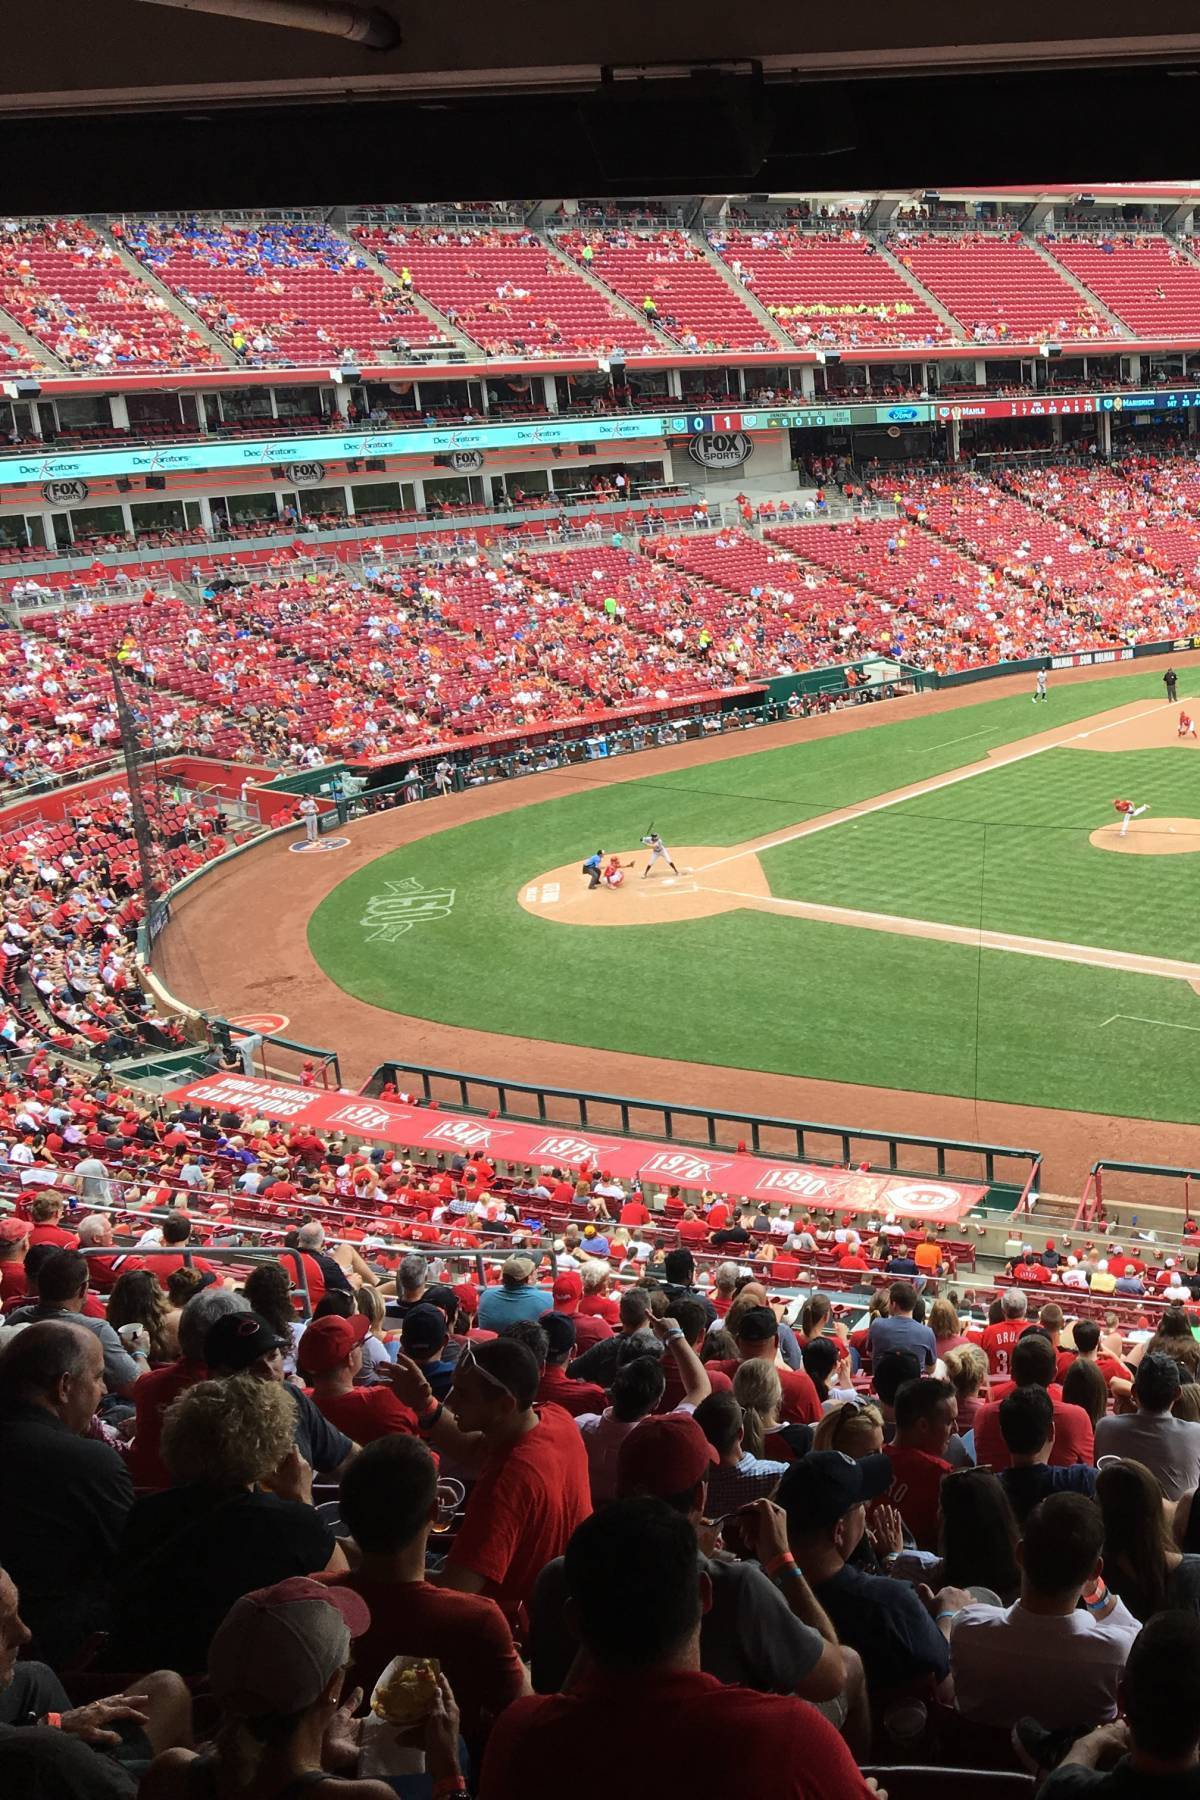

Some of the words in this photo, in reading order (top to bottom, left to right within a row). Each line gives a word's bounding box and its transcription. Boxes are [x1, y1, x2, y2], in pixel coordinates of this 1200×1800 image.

[694, 418, 704, 430] 0
[723, 416, 731, 429] 1
[702, 434, 739, 452] FOX
[456, 452, 478, 463] FOX
[703, 452, 741, 461] SPORTS
[293, 464, 318, 475] FOX
[52, 483, 79, 495] FOX
[186, 1086, 307, 1116] CHAMPIONS
[216, 1078, 272, 1094] WORLD
[264, 1087, 321, 1104] SERIES
[336, 1105, 386, 1129] 1919
[438, 1120, 488, 1145] 1940
[543, 1137, 591, 1162] 1975
[650, 1153, 711, 1178] 1976
[766, 1170, 824, 1196] 1990
